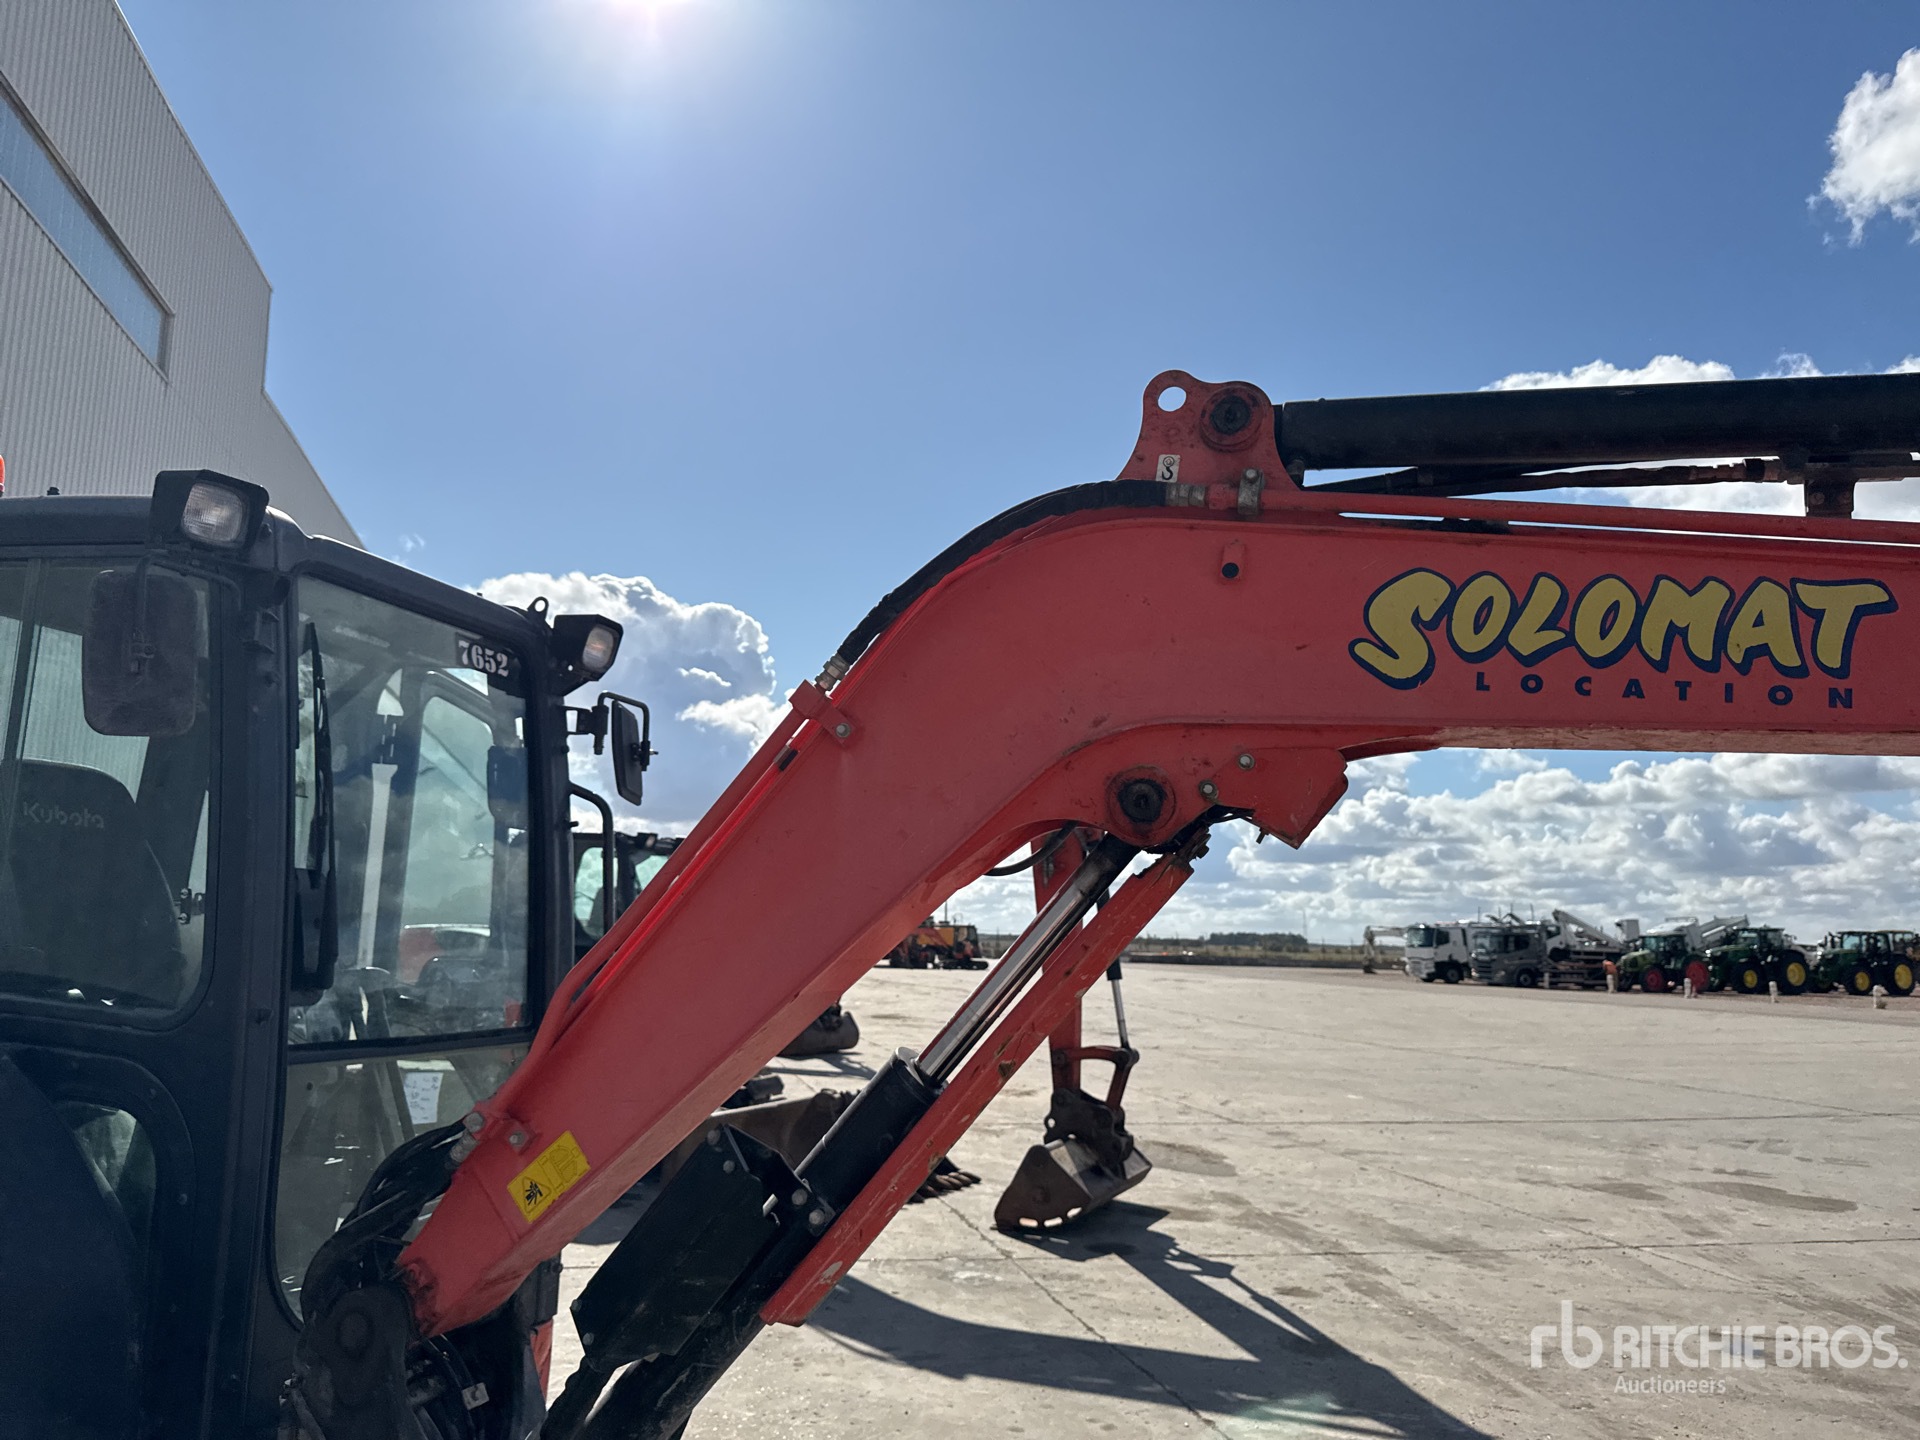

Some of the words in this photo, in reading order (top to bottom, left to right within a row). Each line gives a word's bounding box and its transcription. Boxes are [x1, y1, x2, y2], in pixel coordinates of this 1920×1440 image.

[1348, 567, 1899, 690] SOLOMAT
[458, 640, 509, 677] 7652
[1475, 671, 1853, 709] LOCATION
[23, 801, 105, 829] Kubota
